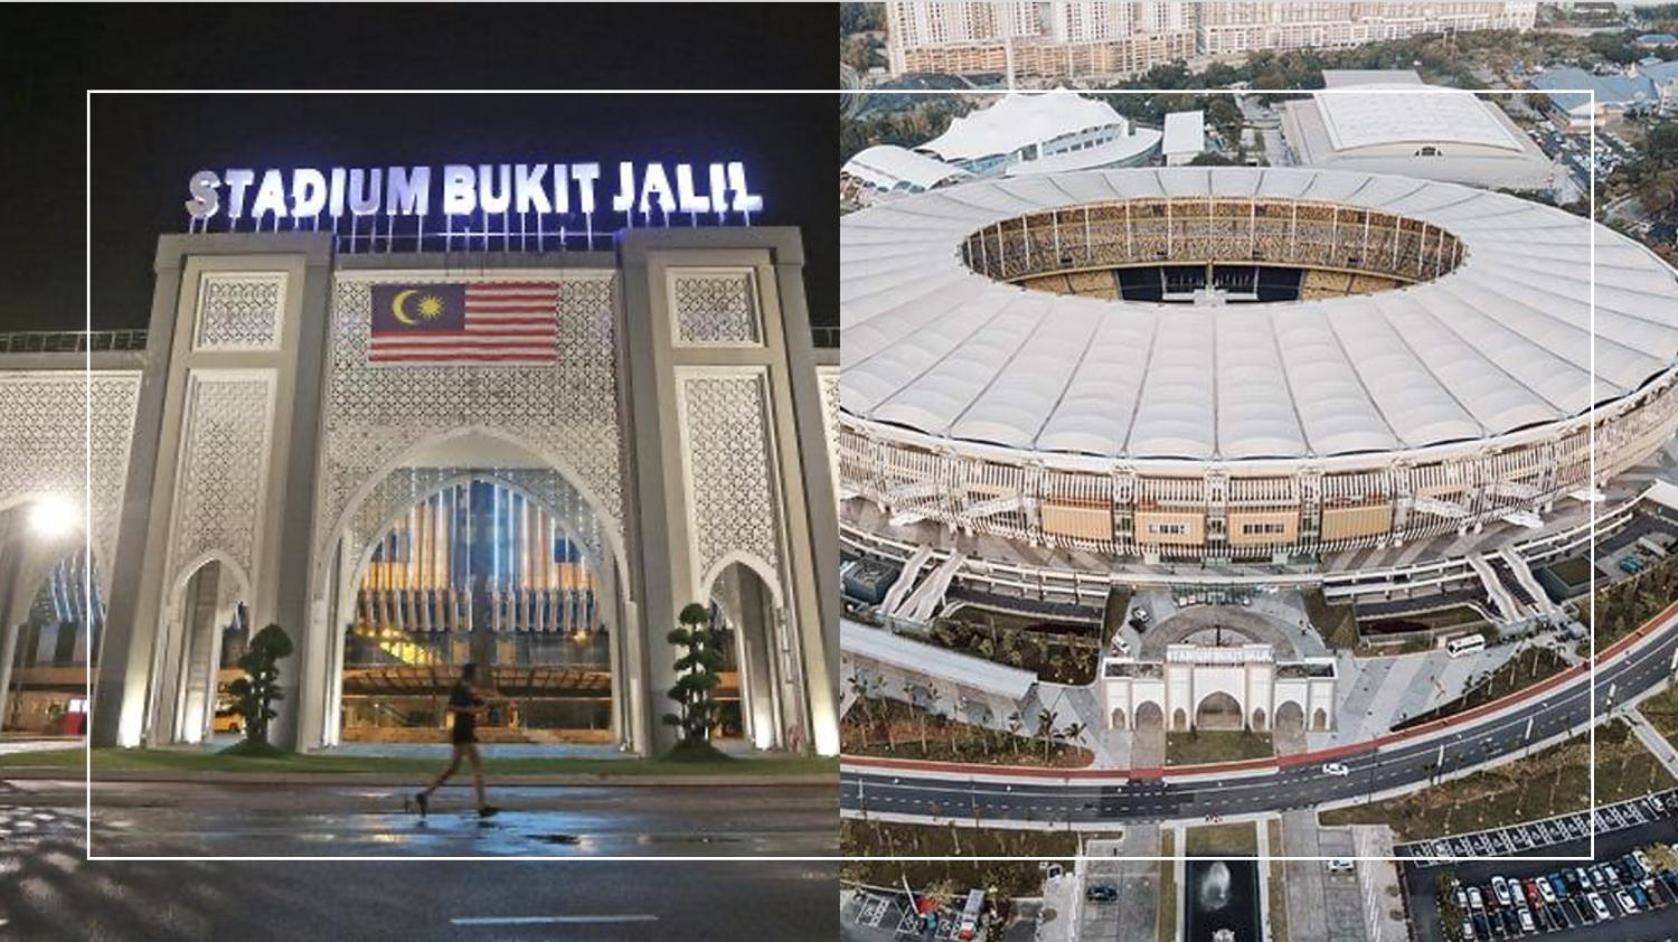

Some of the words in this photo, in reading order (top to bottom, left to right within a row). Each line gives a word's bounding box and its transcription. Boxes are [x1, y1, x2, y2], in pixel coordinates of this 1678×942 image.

[185, 166, 431, 219] STADIUM
[443, 163, 600, 215] BUKIT
[613, 161, 763, 213] JALIL
